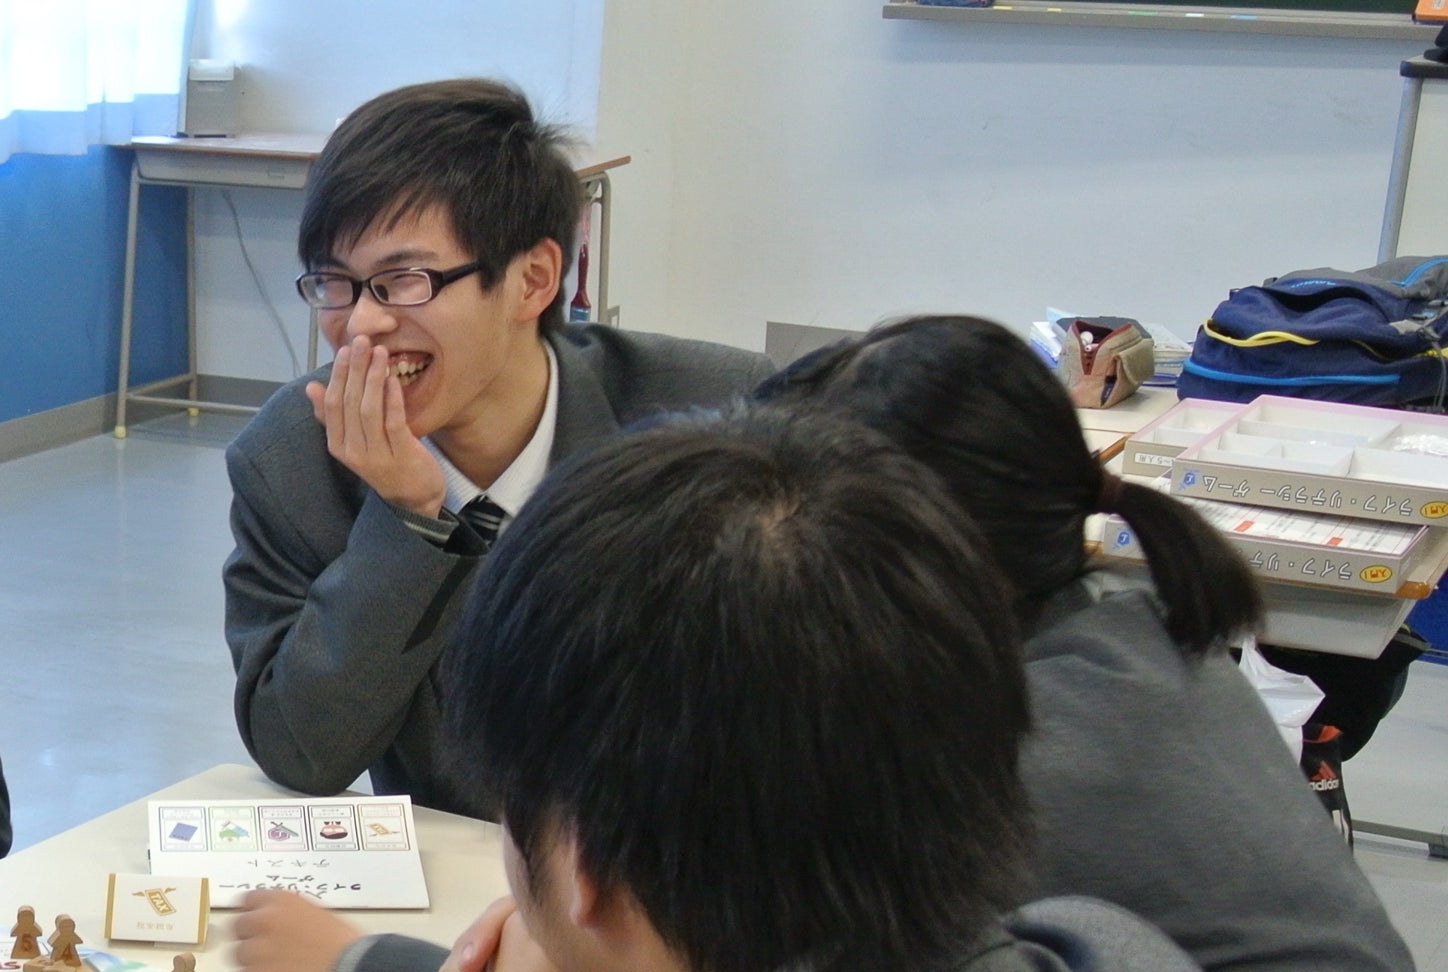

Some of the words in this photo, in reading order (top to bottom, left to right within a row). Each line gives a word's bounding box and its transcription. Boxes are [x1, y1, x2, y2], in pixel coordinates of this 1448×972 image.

[1203, 475, 1249, 498] ゲーム
[1259, 485, 1412, 515] ライフ・リテラシー
